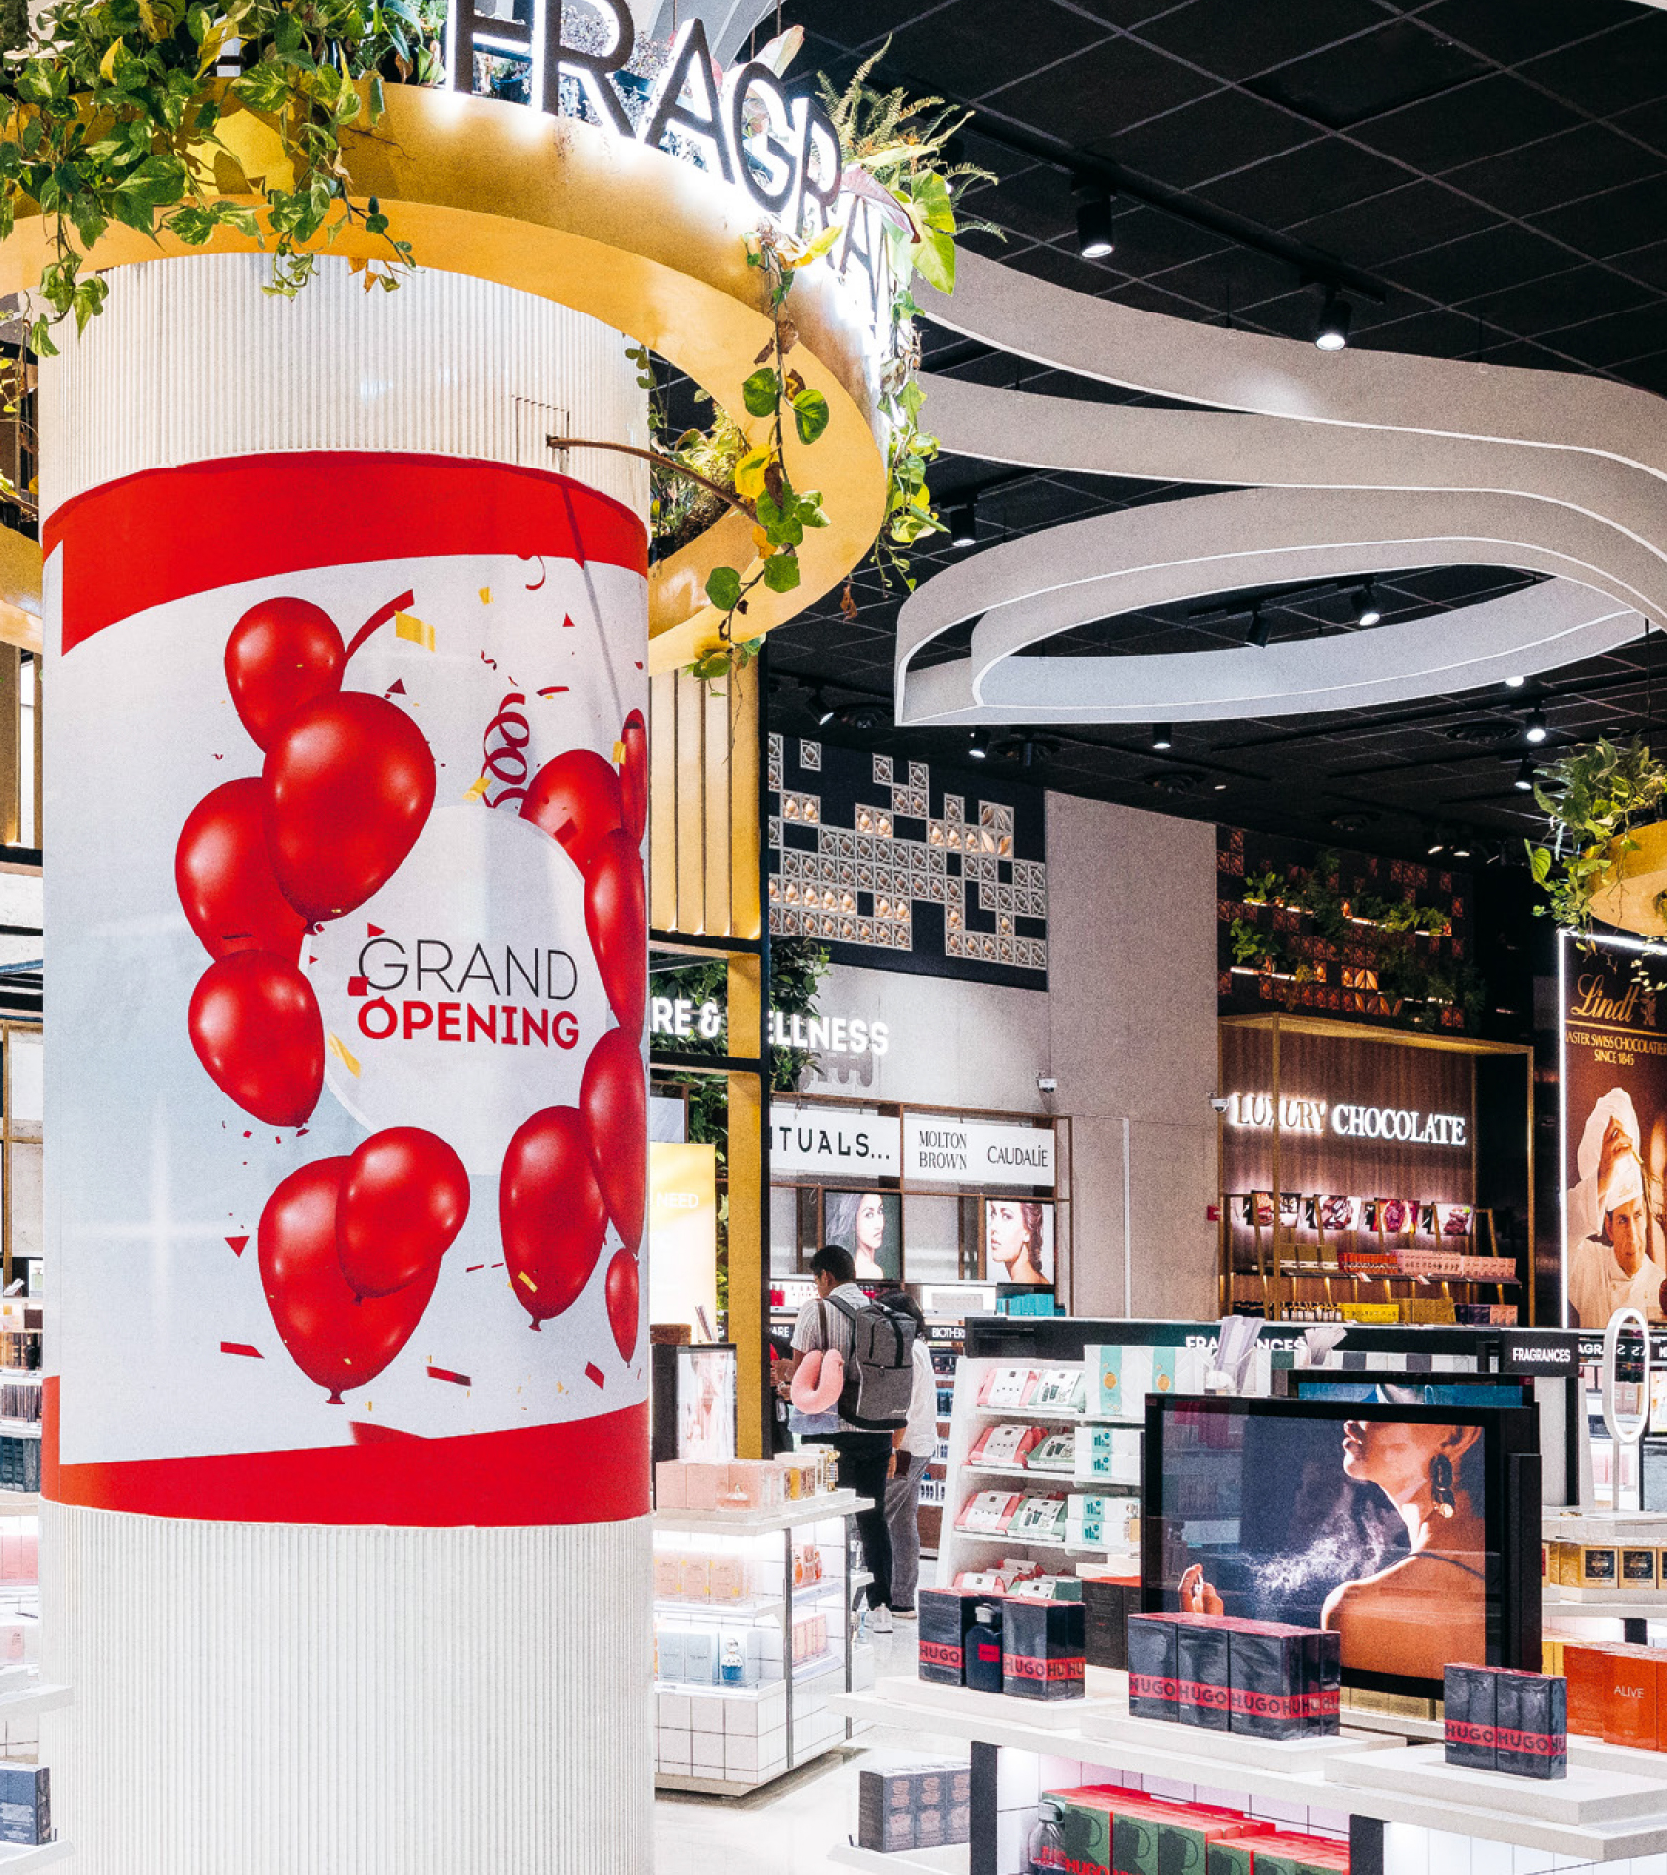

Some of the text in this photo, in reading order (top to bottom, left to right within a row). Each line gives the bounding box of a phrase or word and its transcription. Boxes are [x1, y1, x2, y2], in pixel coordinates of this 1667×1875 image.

[448, 0, 879, 322] FRAGRA
[359, 938, 578, 1000] GRAND
[1570, 974, 1639, 1022] Lindt
[358, 1000, 580, 1050] OPENING
[650, 997, 692, 1036] RE
[698, 1001, 721, 1039] &
[1594, 1049, 1616, 1064] SINCE
[1332, 1105, 1466, 1145] CHOCOLATE
[769, 1126, 890, 1160] ITUALS...
[919, 1130, 967, 1149] MOLTON
[919, 1152, 967, 1169] BROWN
[771, 1326, 790, 1338] ARE
[1512, 1347, 1571, 1363] FRAGRANCES
[920, 1645, 960, 1662] HUGO
[1003, 1660, 1045, 1677] HUGO
[1130, 1676, 1176, 1697] HUGO
[1179, 1684, 1227, 1705] HUGO
[1613, 1685, 1644, 1698] ALIVE
[1232, 1693, 1280, 1713] HUGO
[1446, 1723, 1494, 1742] HUGO
[1499, 1733, 1548, 1751] HUGO
